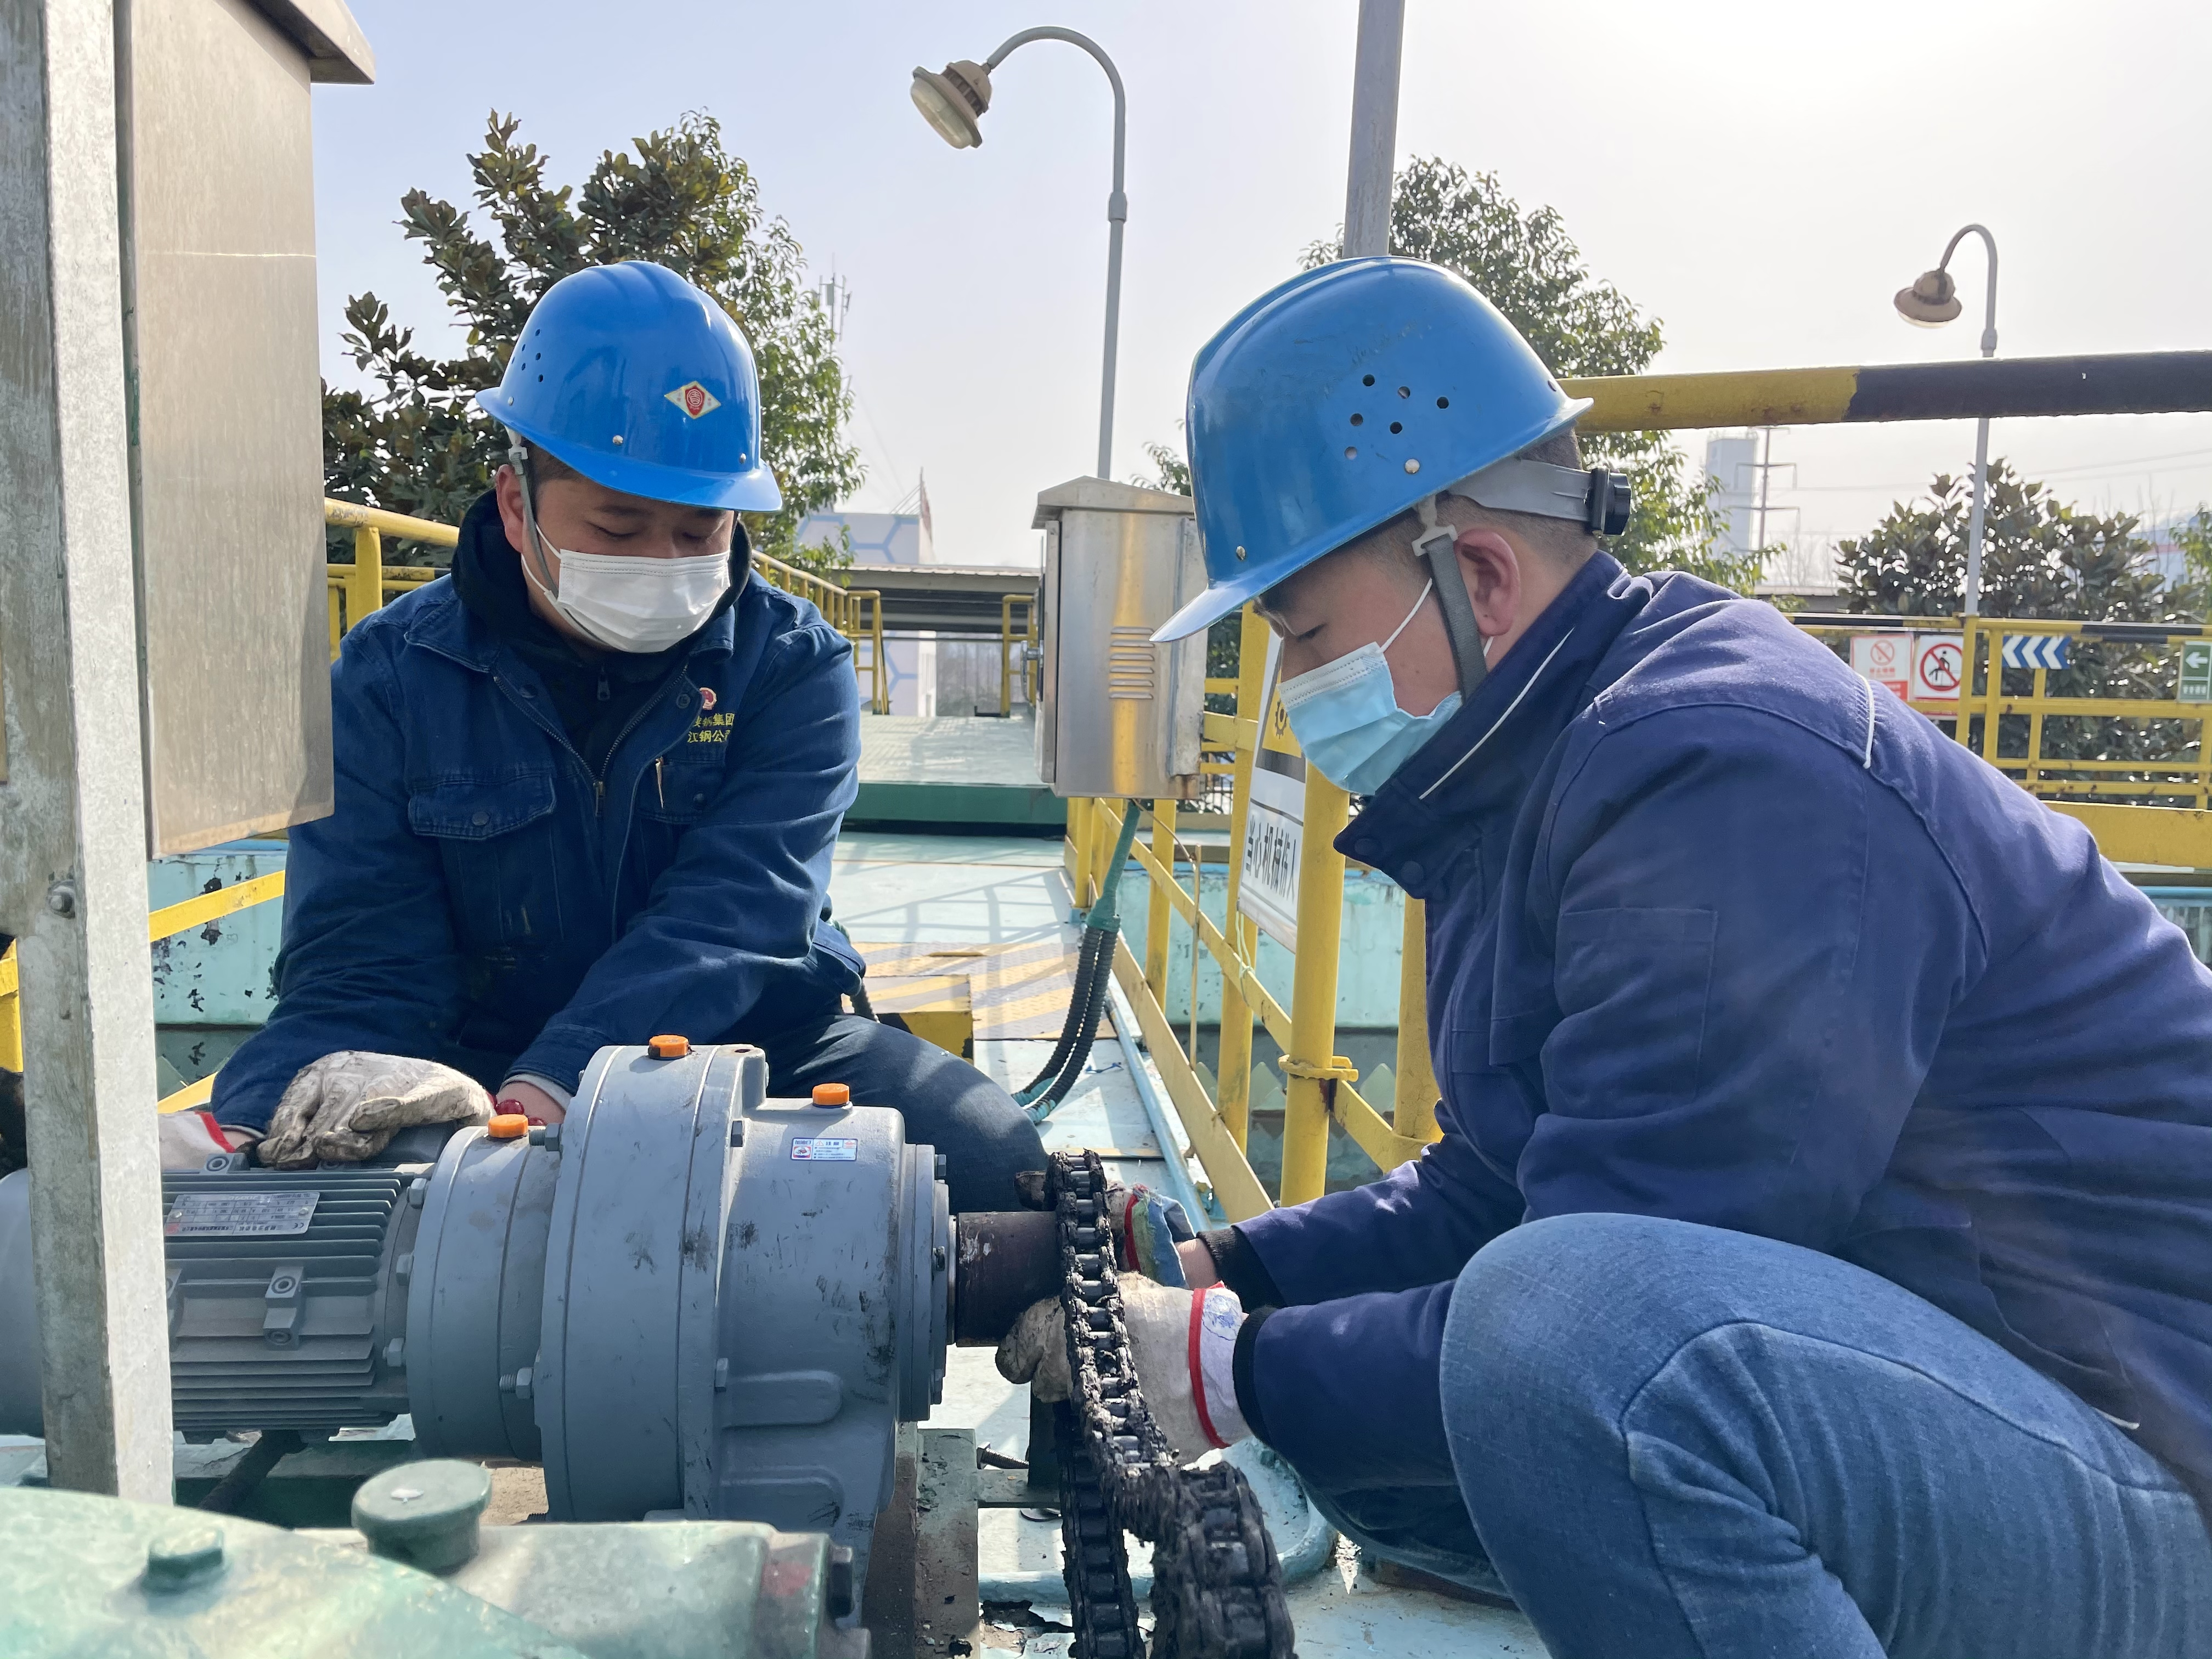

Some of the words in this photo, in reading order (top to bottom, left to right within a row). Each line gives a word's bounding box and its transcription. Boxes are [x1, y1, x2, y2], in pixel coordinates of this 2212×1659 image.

[1245, 815, 1296, 904] 当心机械伤人
